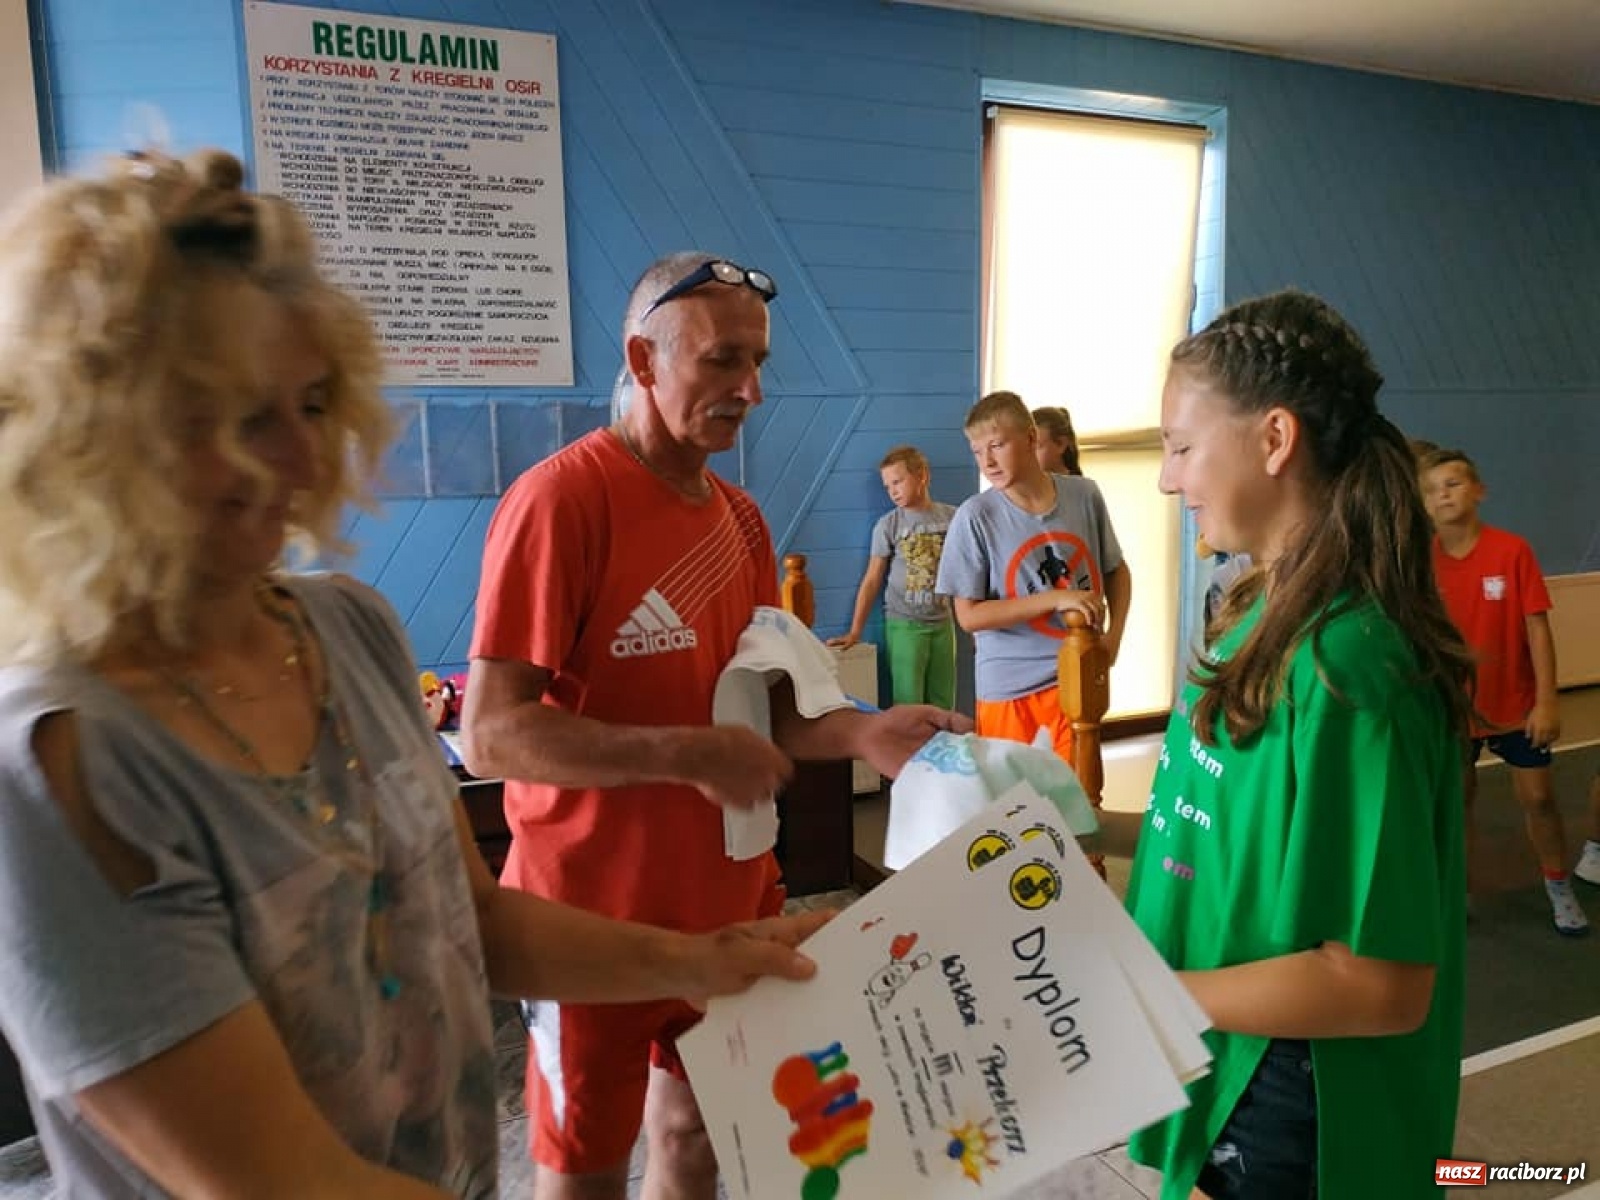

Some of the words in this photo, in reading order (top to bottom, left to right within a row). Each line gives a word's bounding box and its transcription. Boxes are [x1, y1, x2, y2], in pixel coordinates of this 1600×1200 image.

[312, 20, 499, 71] REGULAMIN
[264, 54, 378, 81] KORZYSTANIA
[389, 67, 400, 82] Z
[610, 628, 698, 659] adidas
[1012, 926, 1090, 1074] Dyplom
